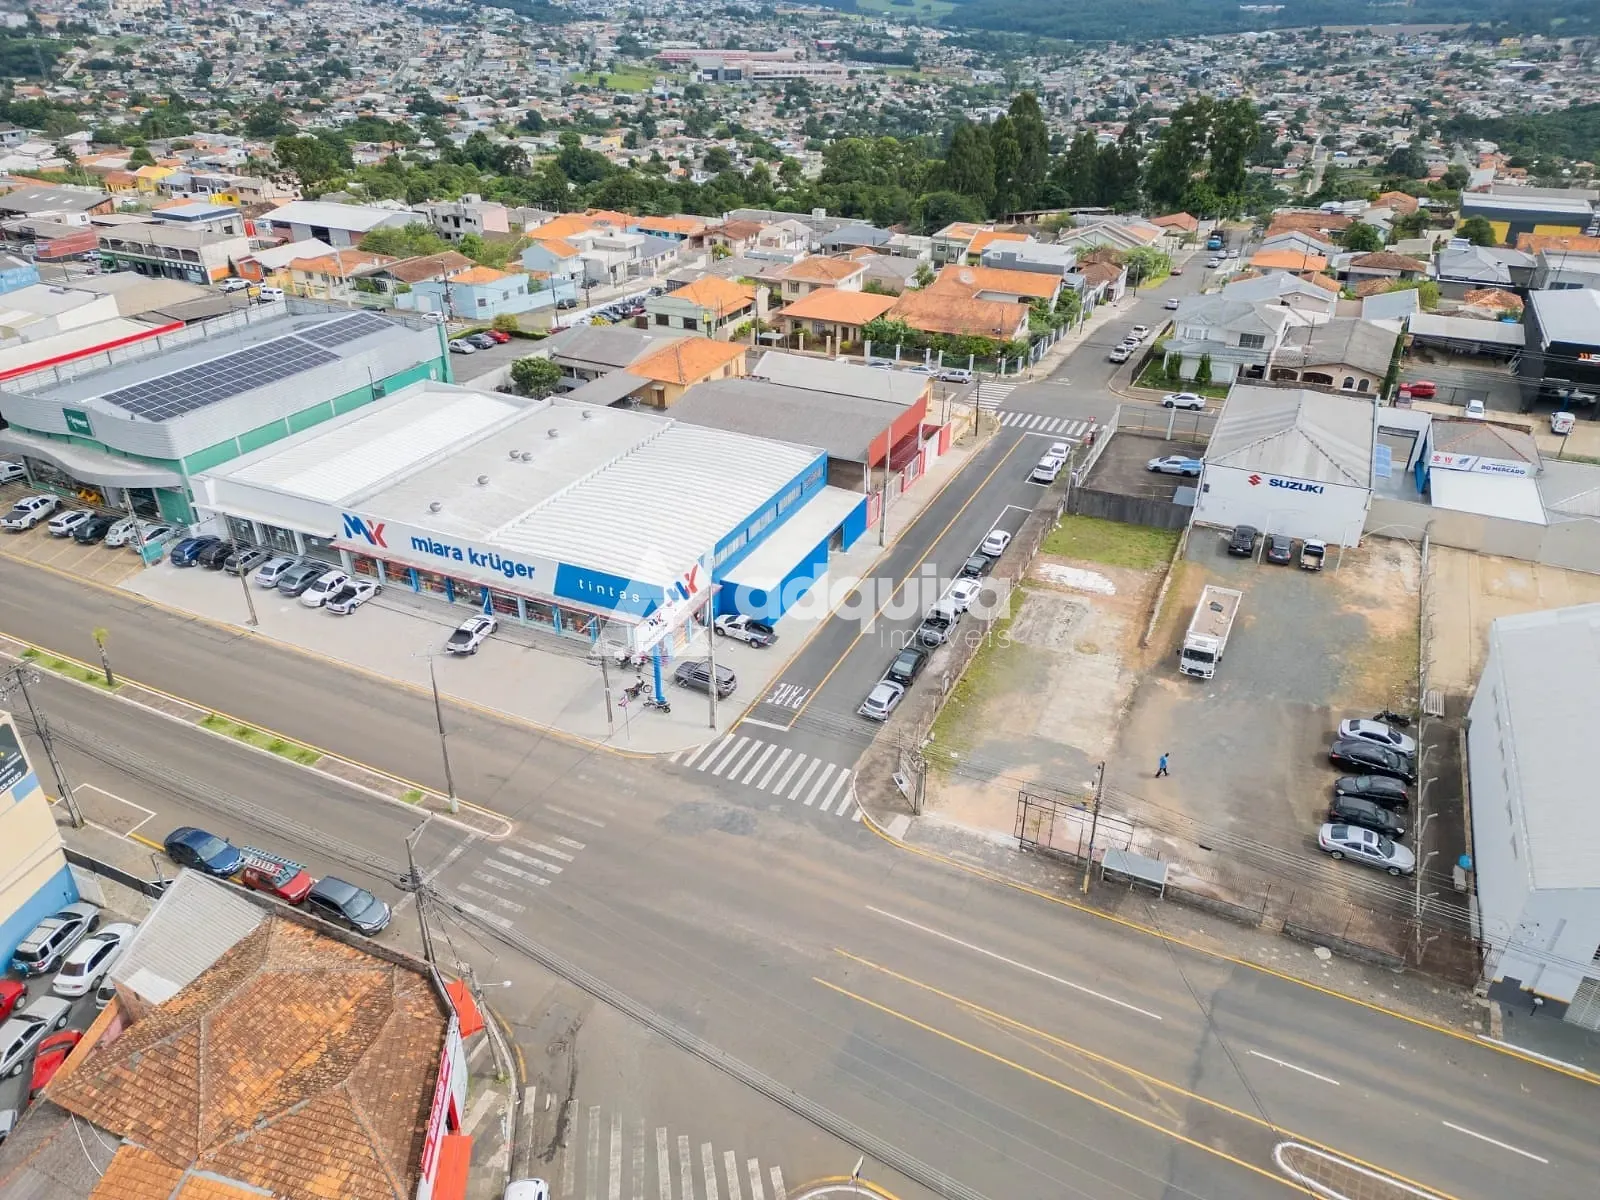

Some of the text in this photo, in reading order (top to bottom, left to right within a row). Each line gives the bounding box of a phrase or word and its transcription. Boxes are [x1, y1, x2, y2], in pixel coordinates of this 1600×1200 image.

[1269, 478, 1324, 494] SUZUKI
[410, 535, 536, 580] miara krüger
[578, 579, 640, 603] tintas
